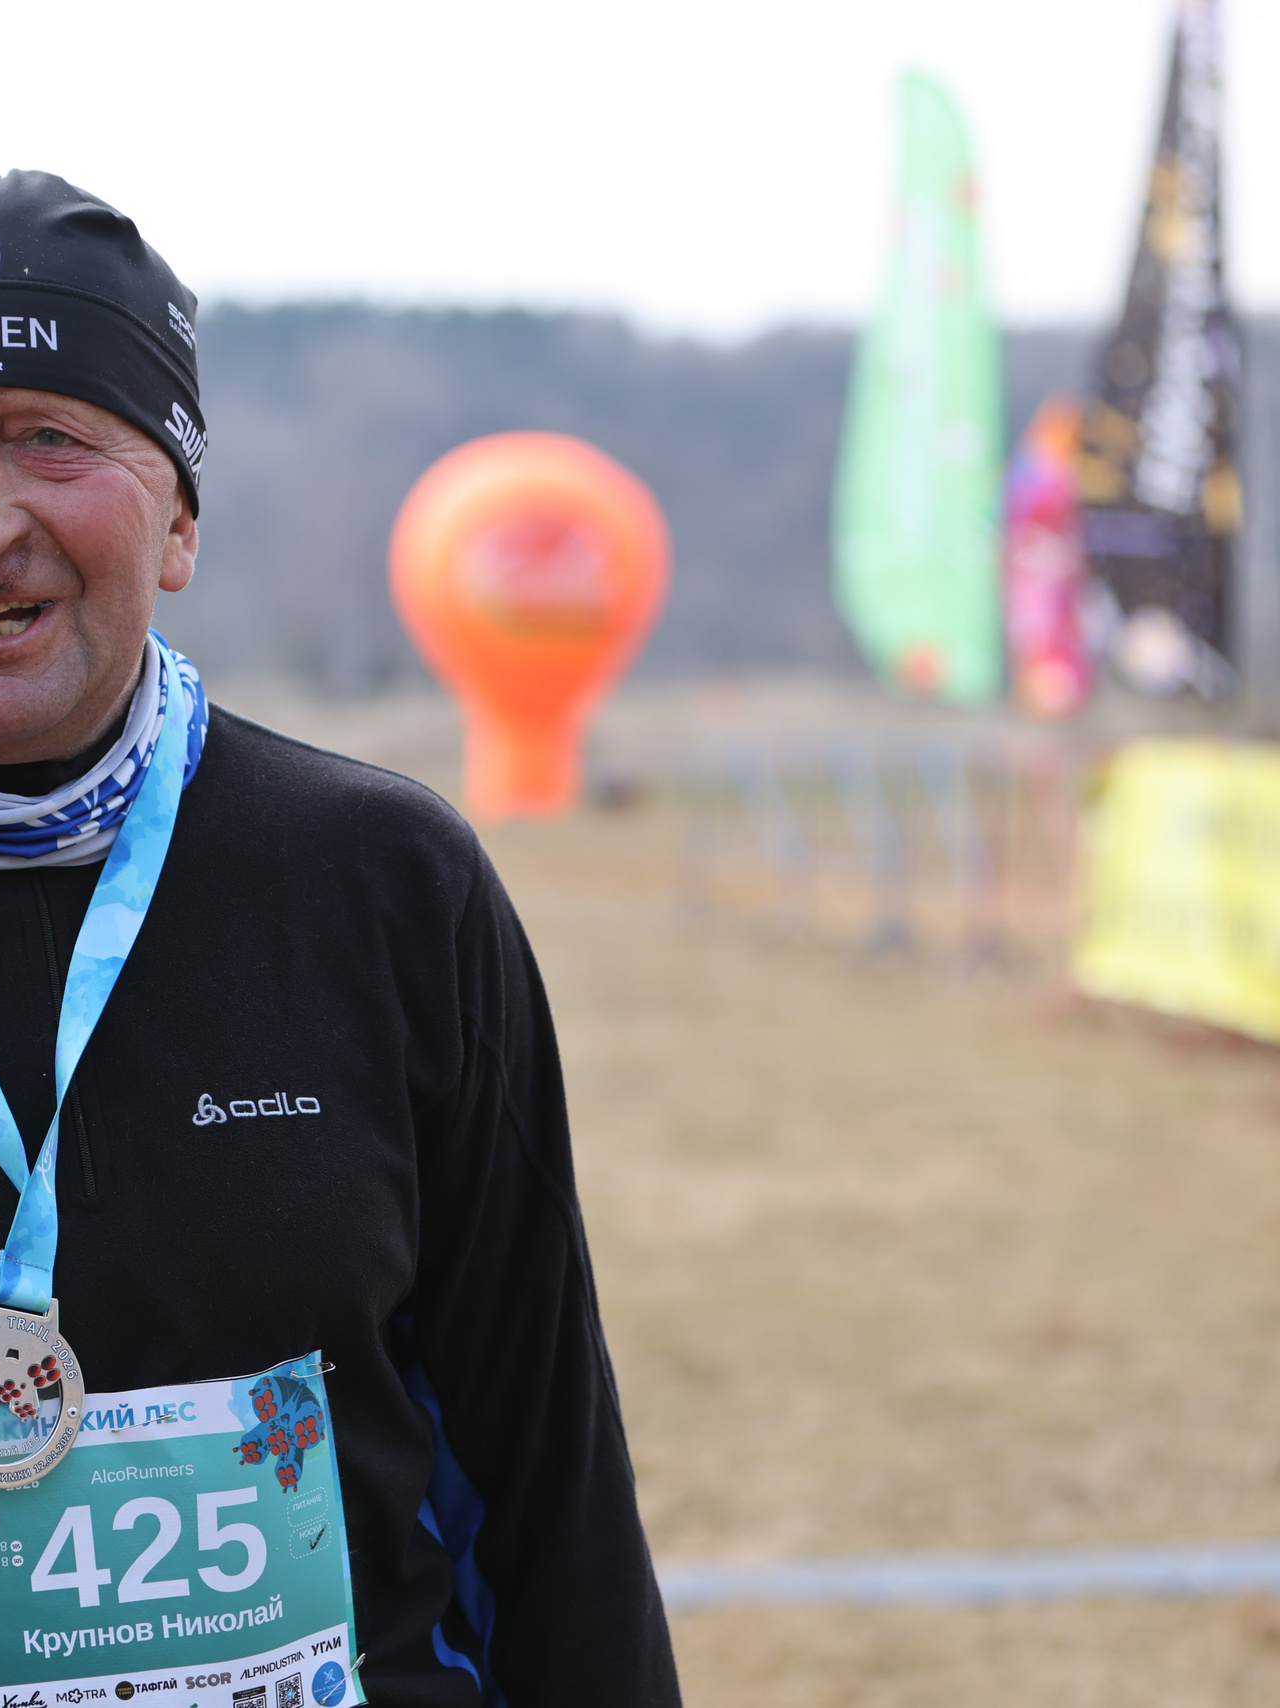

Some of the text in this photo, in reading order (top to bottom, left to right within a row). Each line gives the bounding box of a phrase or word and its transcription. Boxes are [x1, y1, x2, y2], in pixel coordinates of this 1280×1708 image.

[167, 301, 197, 345] spo
[229, 1092, 320, 1117] odlo
[6, 1316, 50, 1343] TRAIL
[50, 1339, 78, 1380] 2026
[144, 1401, 197, 1427] ЛЕС
[22, 1434, 41, 1452] ЛЕС
[32, 1427, 75, 1475] 12.04.2026
[91, 1463, 195, 1484] AlcoRunners
[292, 1493, 323, 1512] ПИТАНИЕ
[299, 1524, 323, 1539] НОСКИ
[0, 1541, 8, 1551] 8
[31, 1486, 278, 1608] 425
[1, 1556, 9, 1567] 8
[23, 1594, 283, 1658] Крупнов Николай
[240, 1651, 305, 1681] ALPINDUSTRIA
[135, 1677, 178, 1693] ТАФГАЙ
[185, 1672, 232, 1690] SCOR
